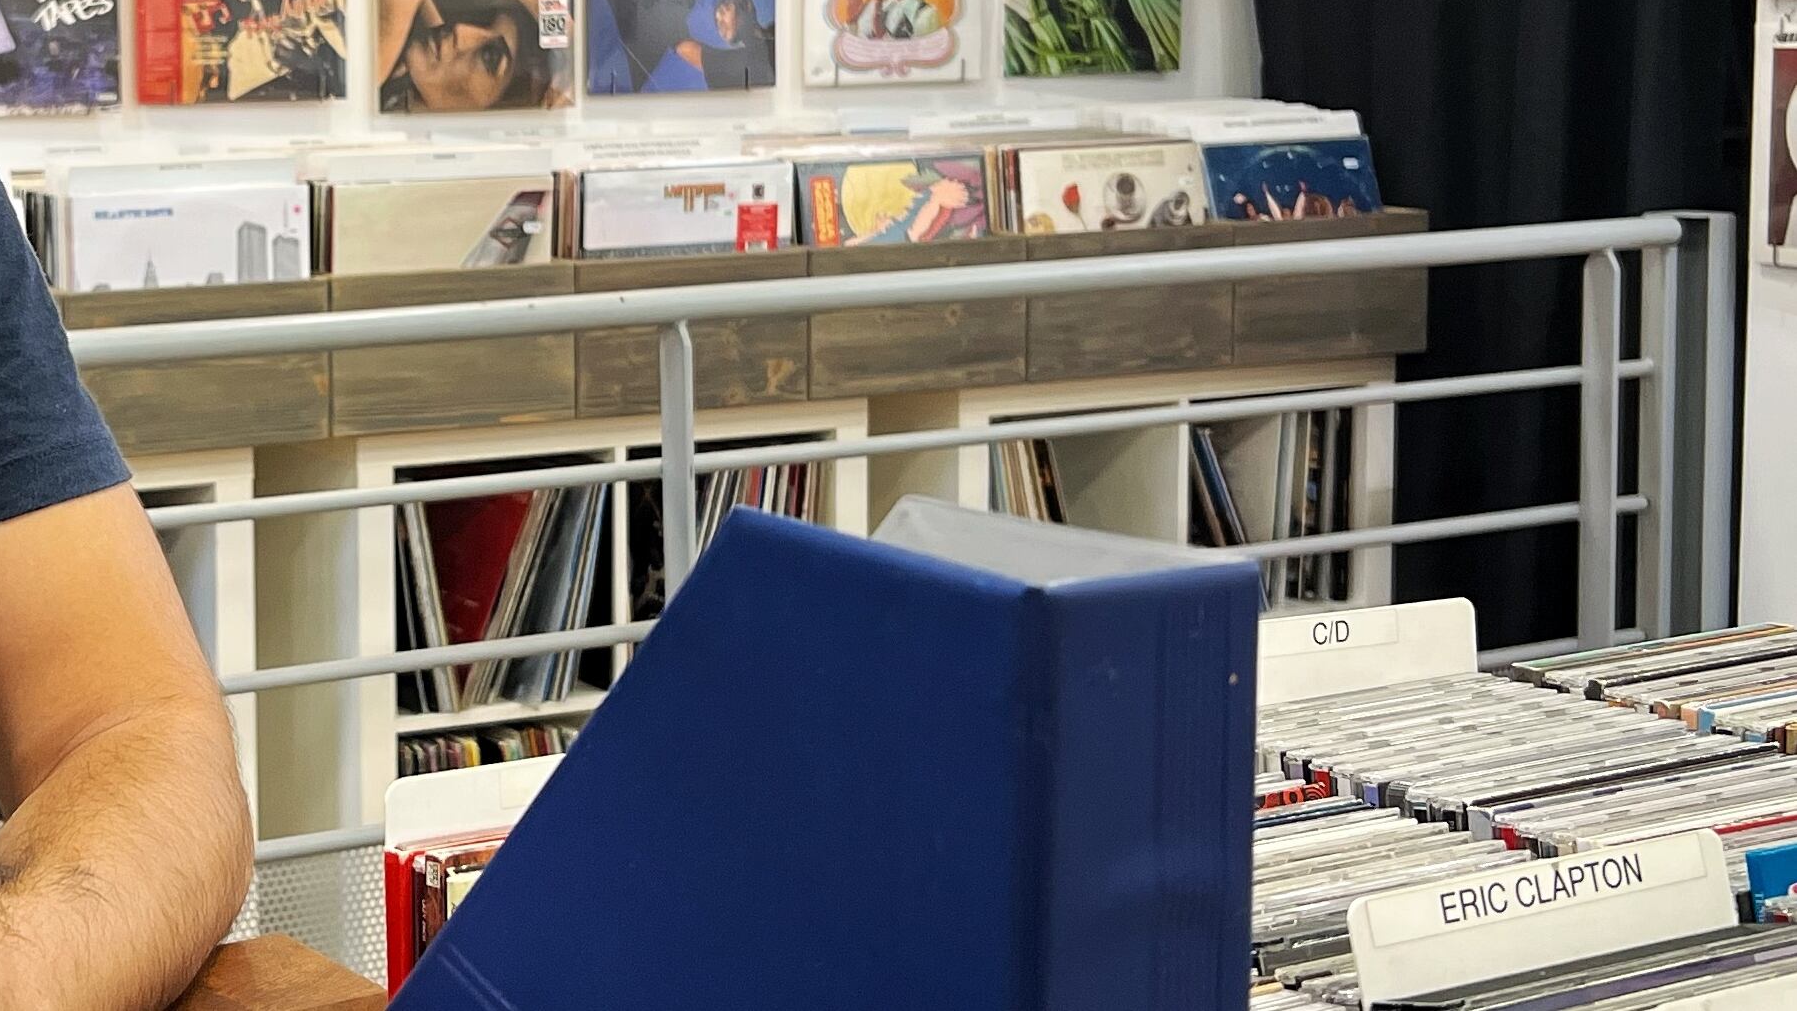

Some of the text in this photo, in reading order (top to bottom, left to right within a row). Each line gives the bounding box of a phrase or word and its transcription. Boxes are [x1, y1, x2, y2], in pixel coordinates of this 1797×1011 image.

[1312, 620, 1350, 645] C/D
[1440, 854, 1644, 925] ERIC CLAPTON
